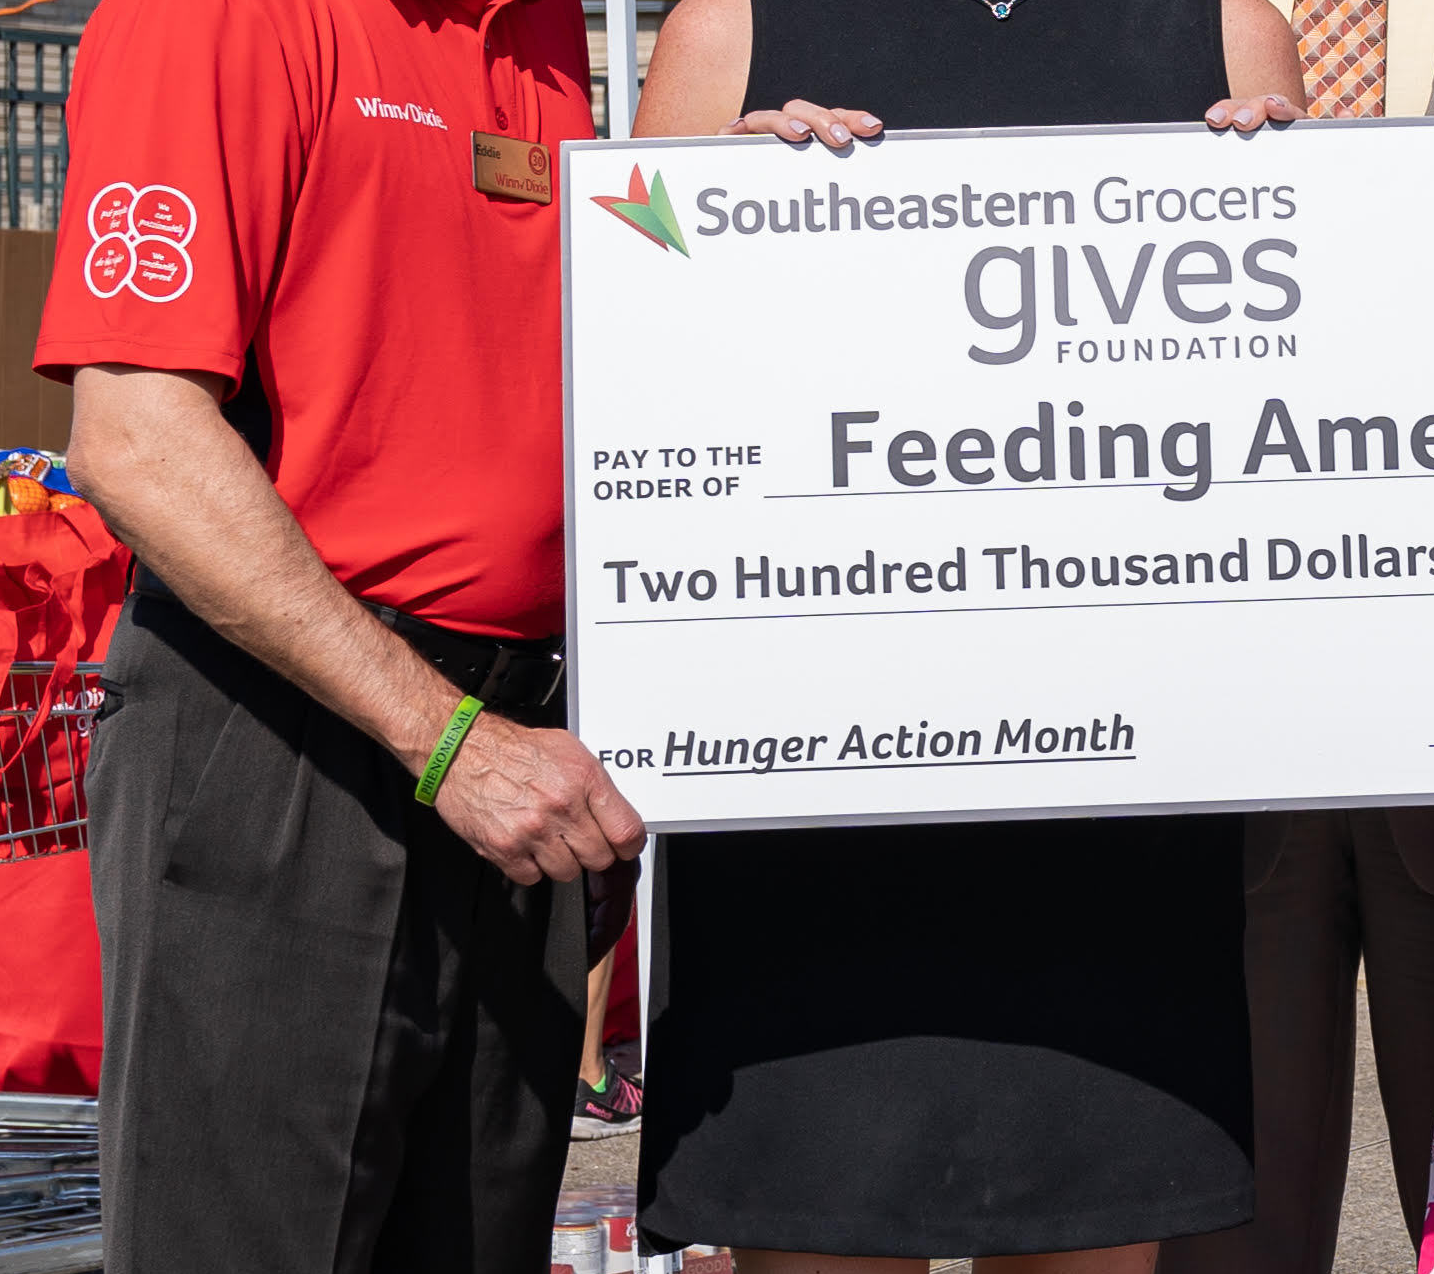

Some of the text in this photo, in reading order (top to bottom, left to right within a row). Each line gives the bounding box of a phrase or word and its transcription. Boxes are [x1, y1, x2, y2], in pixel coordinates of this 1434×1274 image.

[354, 96, 404, 119] Winn
[475, 143, 501, 159] Eddie
[696, 176, 1297, 237] Southeastern Grocers
[964, 238, 1302, 366] gives
[1057, 334, 1297, 364] FOUNDATION
[593, 445, 762, 471] PAY TO THE
[830, 397, 1211, 502] Feeding
[593, 476, 740, 501] ORDER OF
[602, 560, 718, 603] Two
[735, 549, 967, 599] Hundred
[981, 538, 1249, 590] Thousand
[599, 713, 1135, 774] FOR Hunger Action Month
